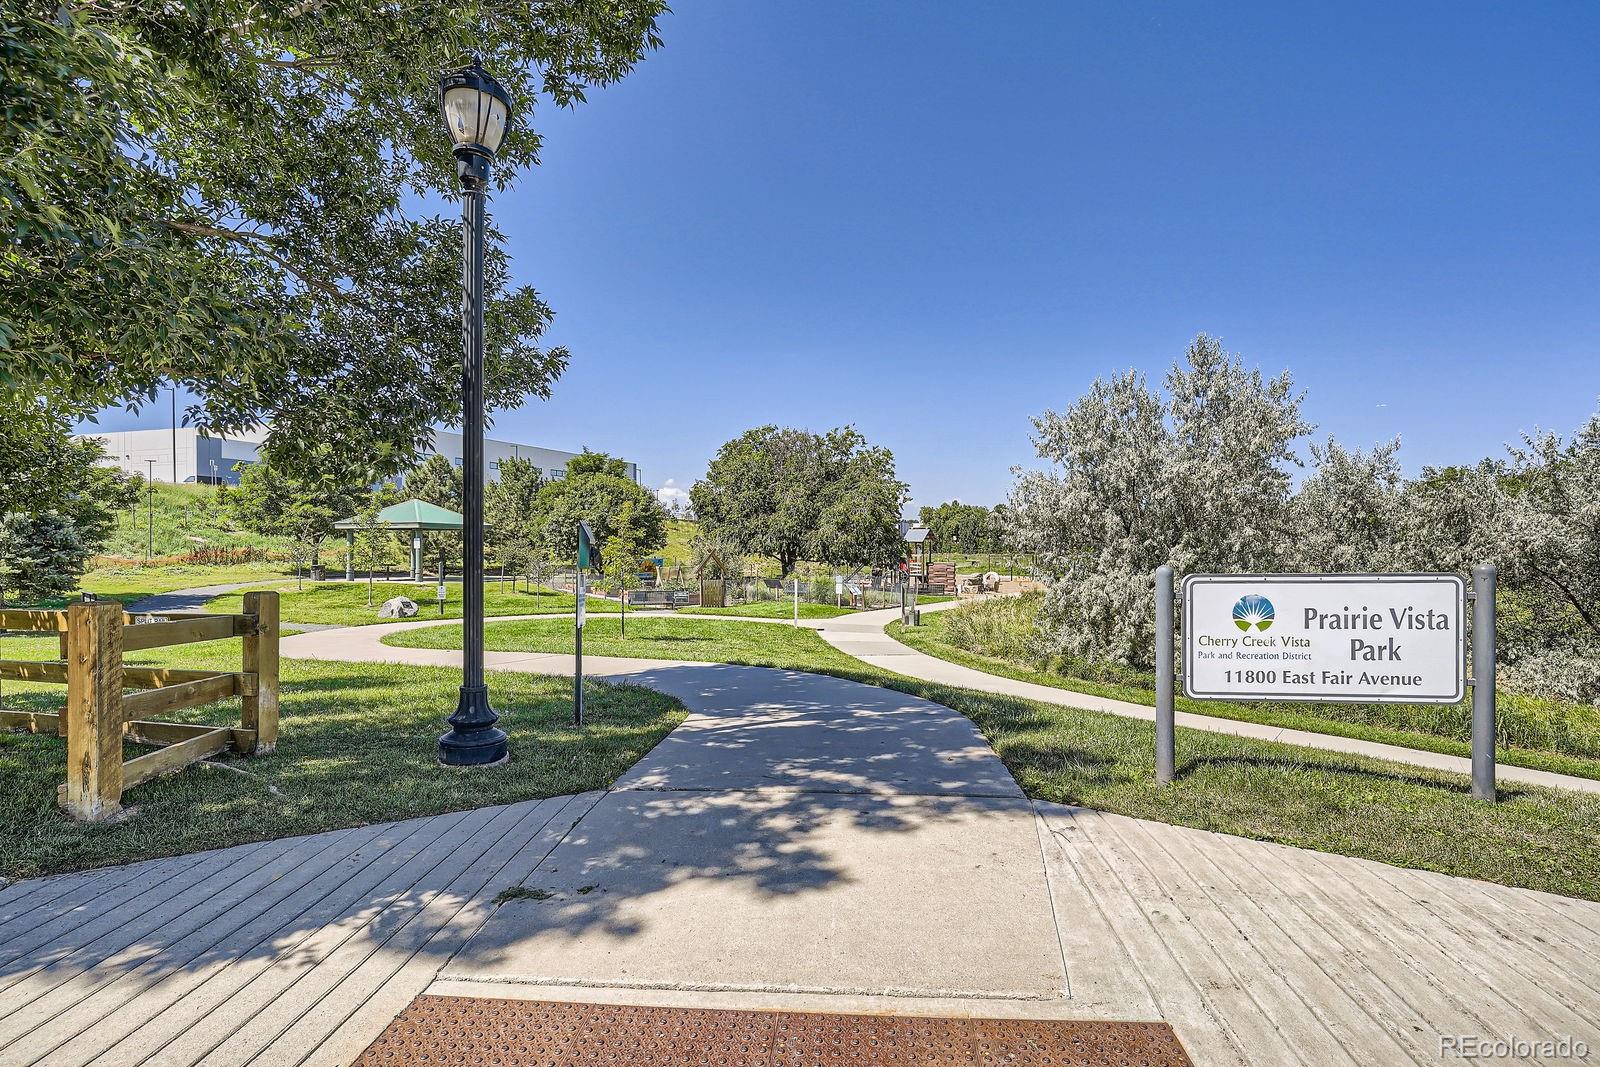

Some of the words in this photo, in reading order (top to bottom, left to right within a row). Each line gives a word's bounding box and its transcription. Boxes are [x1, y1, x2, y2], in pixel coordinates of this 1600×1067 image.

[1304, 606, 1382, 631] Prairie
[1389, 606, 1450, 631] Vista
[1198, 635, 1239, 649] Cherry
[1242, 635, 1277, 648] Creek
[1280, 636, 1311, 648] Vista
[1350, 637, 1402, 662] Park
[1197, 650, 1215, 660] Park
[1217, 651, 1233, 660] and
[1235, 651, 1280, 660] Recreation
[1282, 651, 1312, 661] District
[1224, 670, 1277, 684] 11800
[1282, 671, 1316, 685] East
[1321, 671, 1354, 685] Fair
[1357, 672, 1423, 687] Avenue
